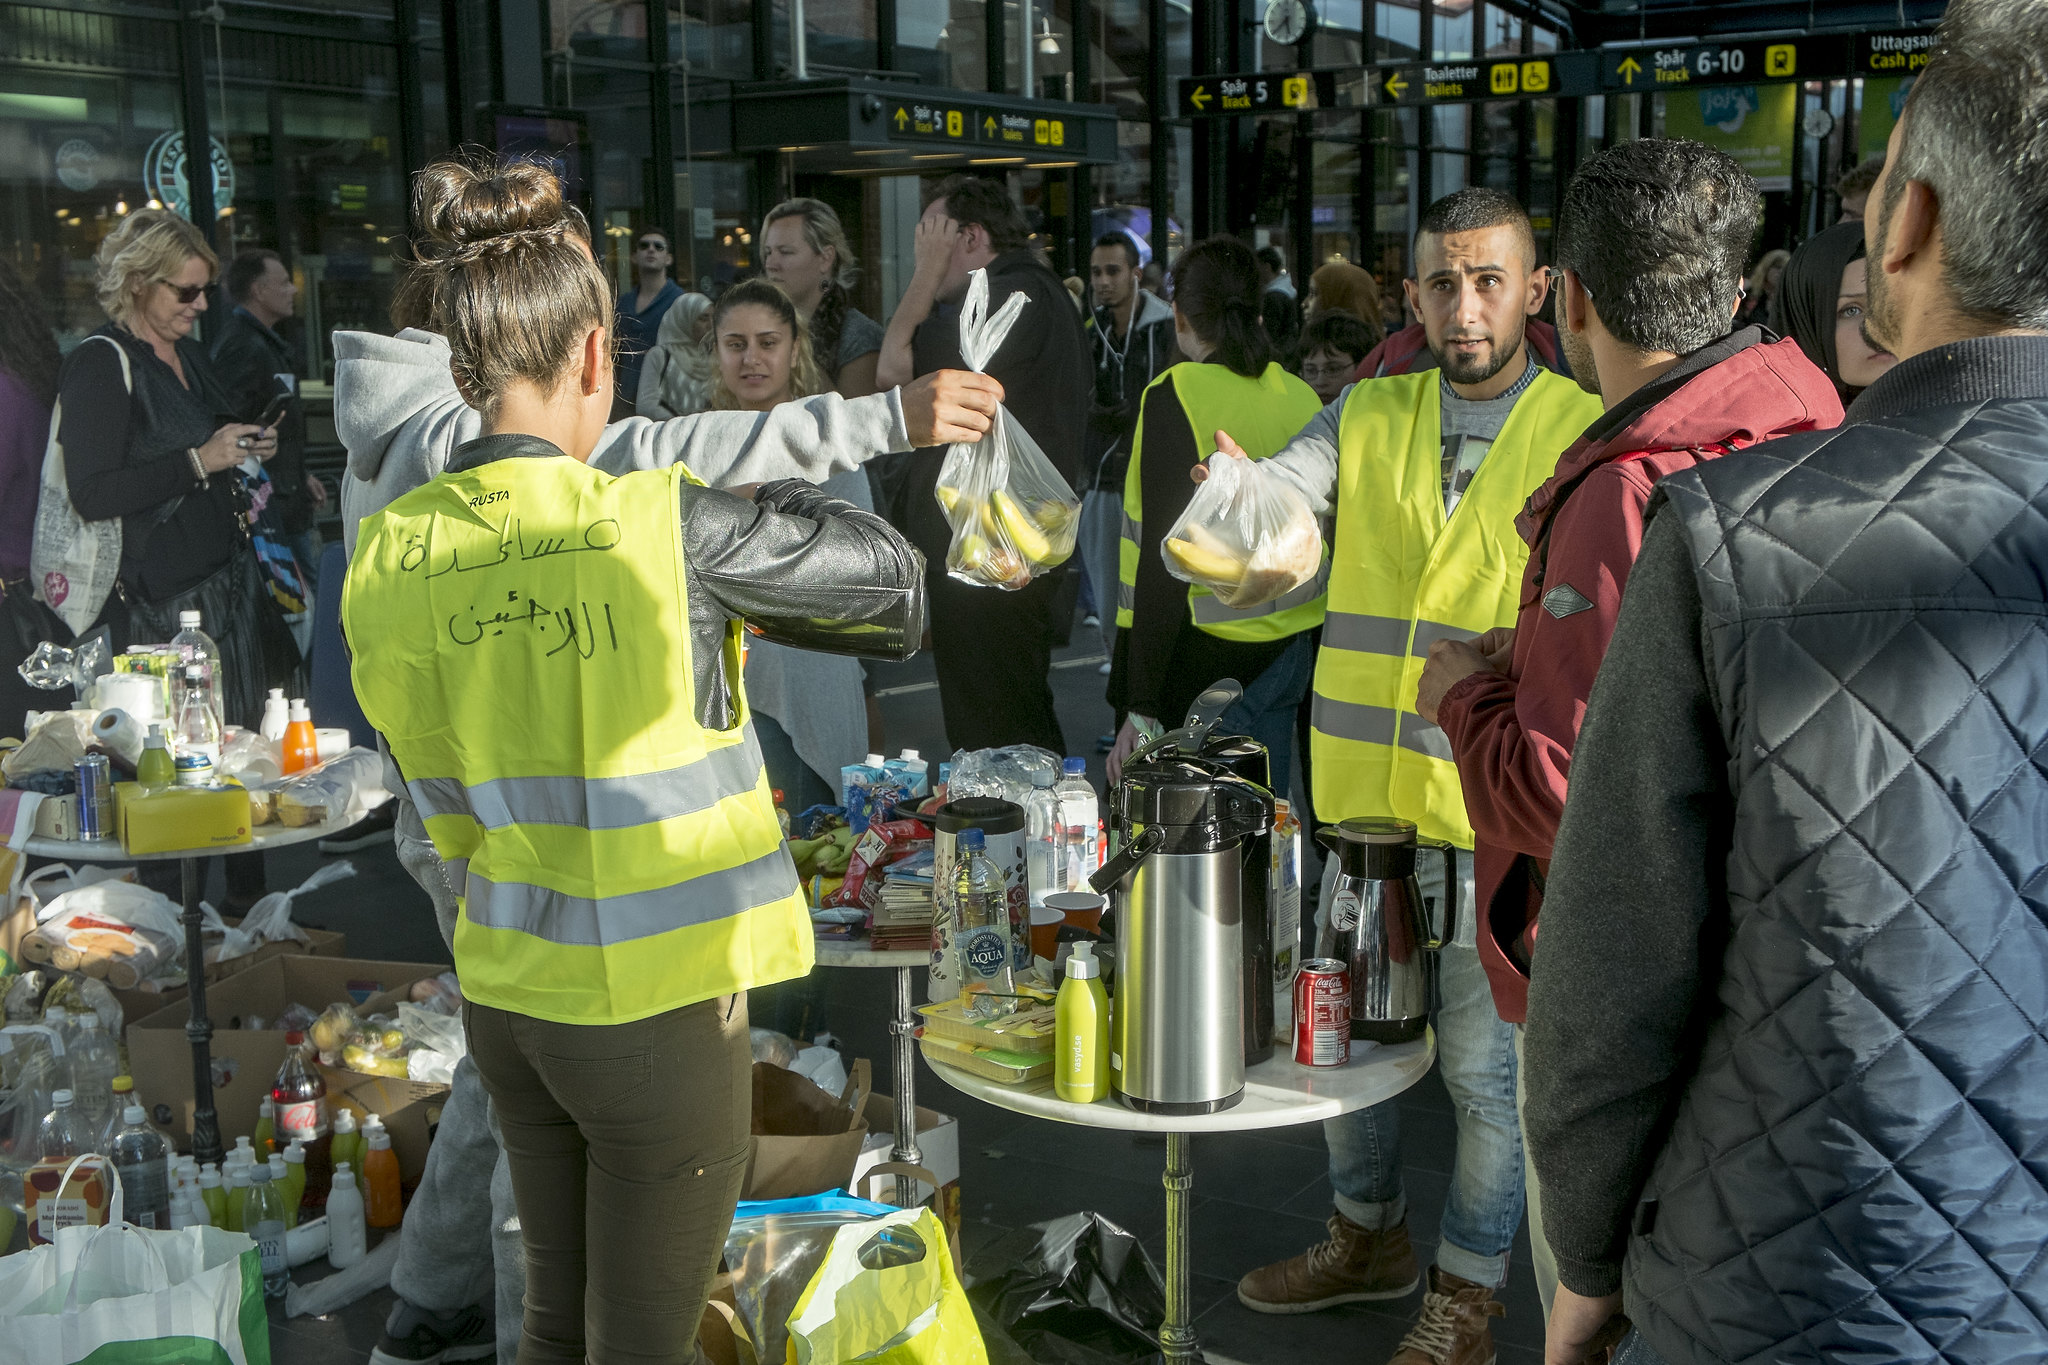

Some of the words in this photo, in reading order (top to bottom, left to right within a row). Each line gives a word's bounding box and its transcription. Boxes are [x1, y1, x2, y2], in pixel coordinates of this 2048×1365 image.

[1870, 34, 1939, 53] Uttagsau
[1654, 49, 1687, 68] Spår
[1696, 49, 1745, 75] 6-10
[1869, 51, 1906, 69] Cash
[1909, 53, 1929, 71] po
[1423, 65, 1479, 82] Toaletter
[1655, 68, 1690, 83] Track
[1220, 78, 1249, 97] Spår
[1255, 81, 1269, 103] 5
[1424, 82, 1464, 98] Toilets
[1221, 94, 1252, 109] Track
[913, 105, 932, 122] Spår
[933, 110, 943, 131] 5
[914, 119, 934, 133] Track
[1001, 114, 1032, 129] Toaletter
[1002, 128, 1024, 142] Toilets
[468, 490, 510, 508] RUSTA
[971, 950, 1004, 965] AQUA
[1072, 1035, 1085, 1073] vasyd.se
